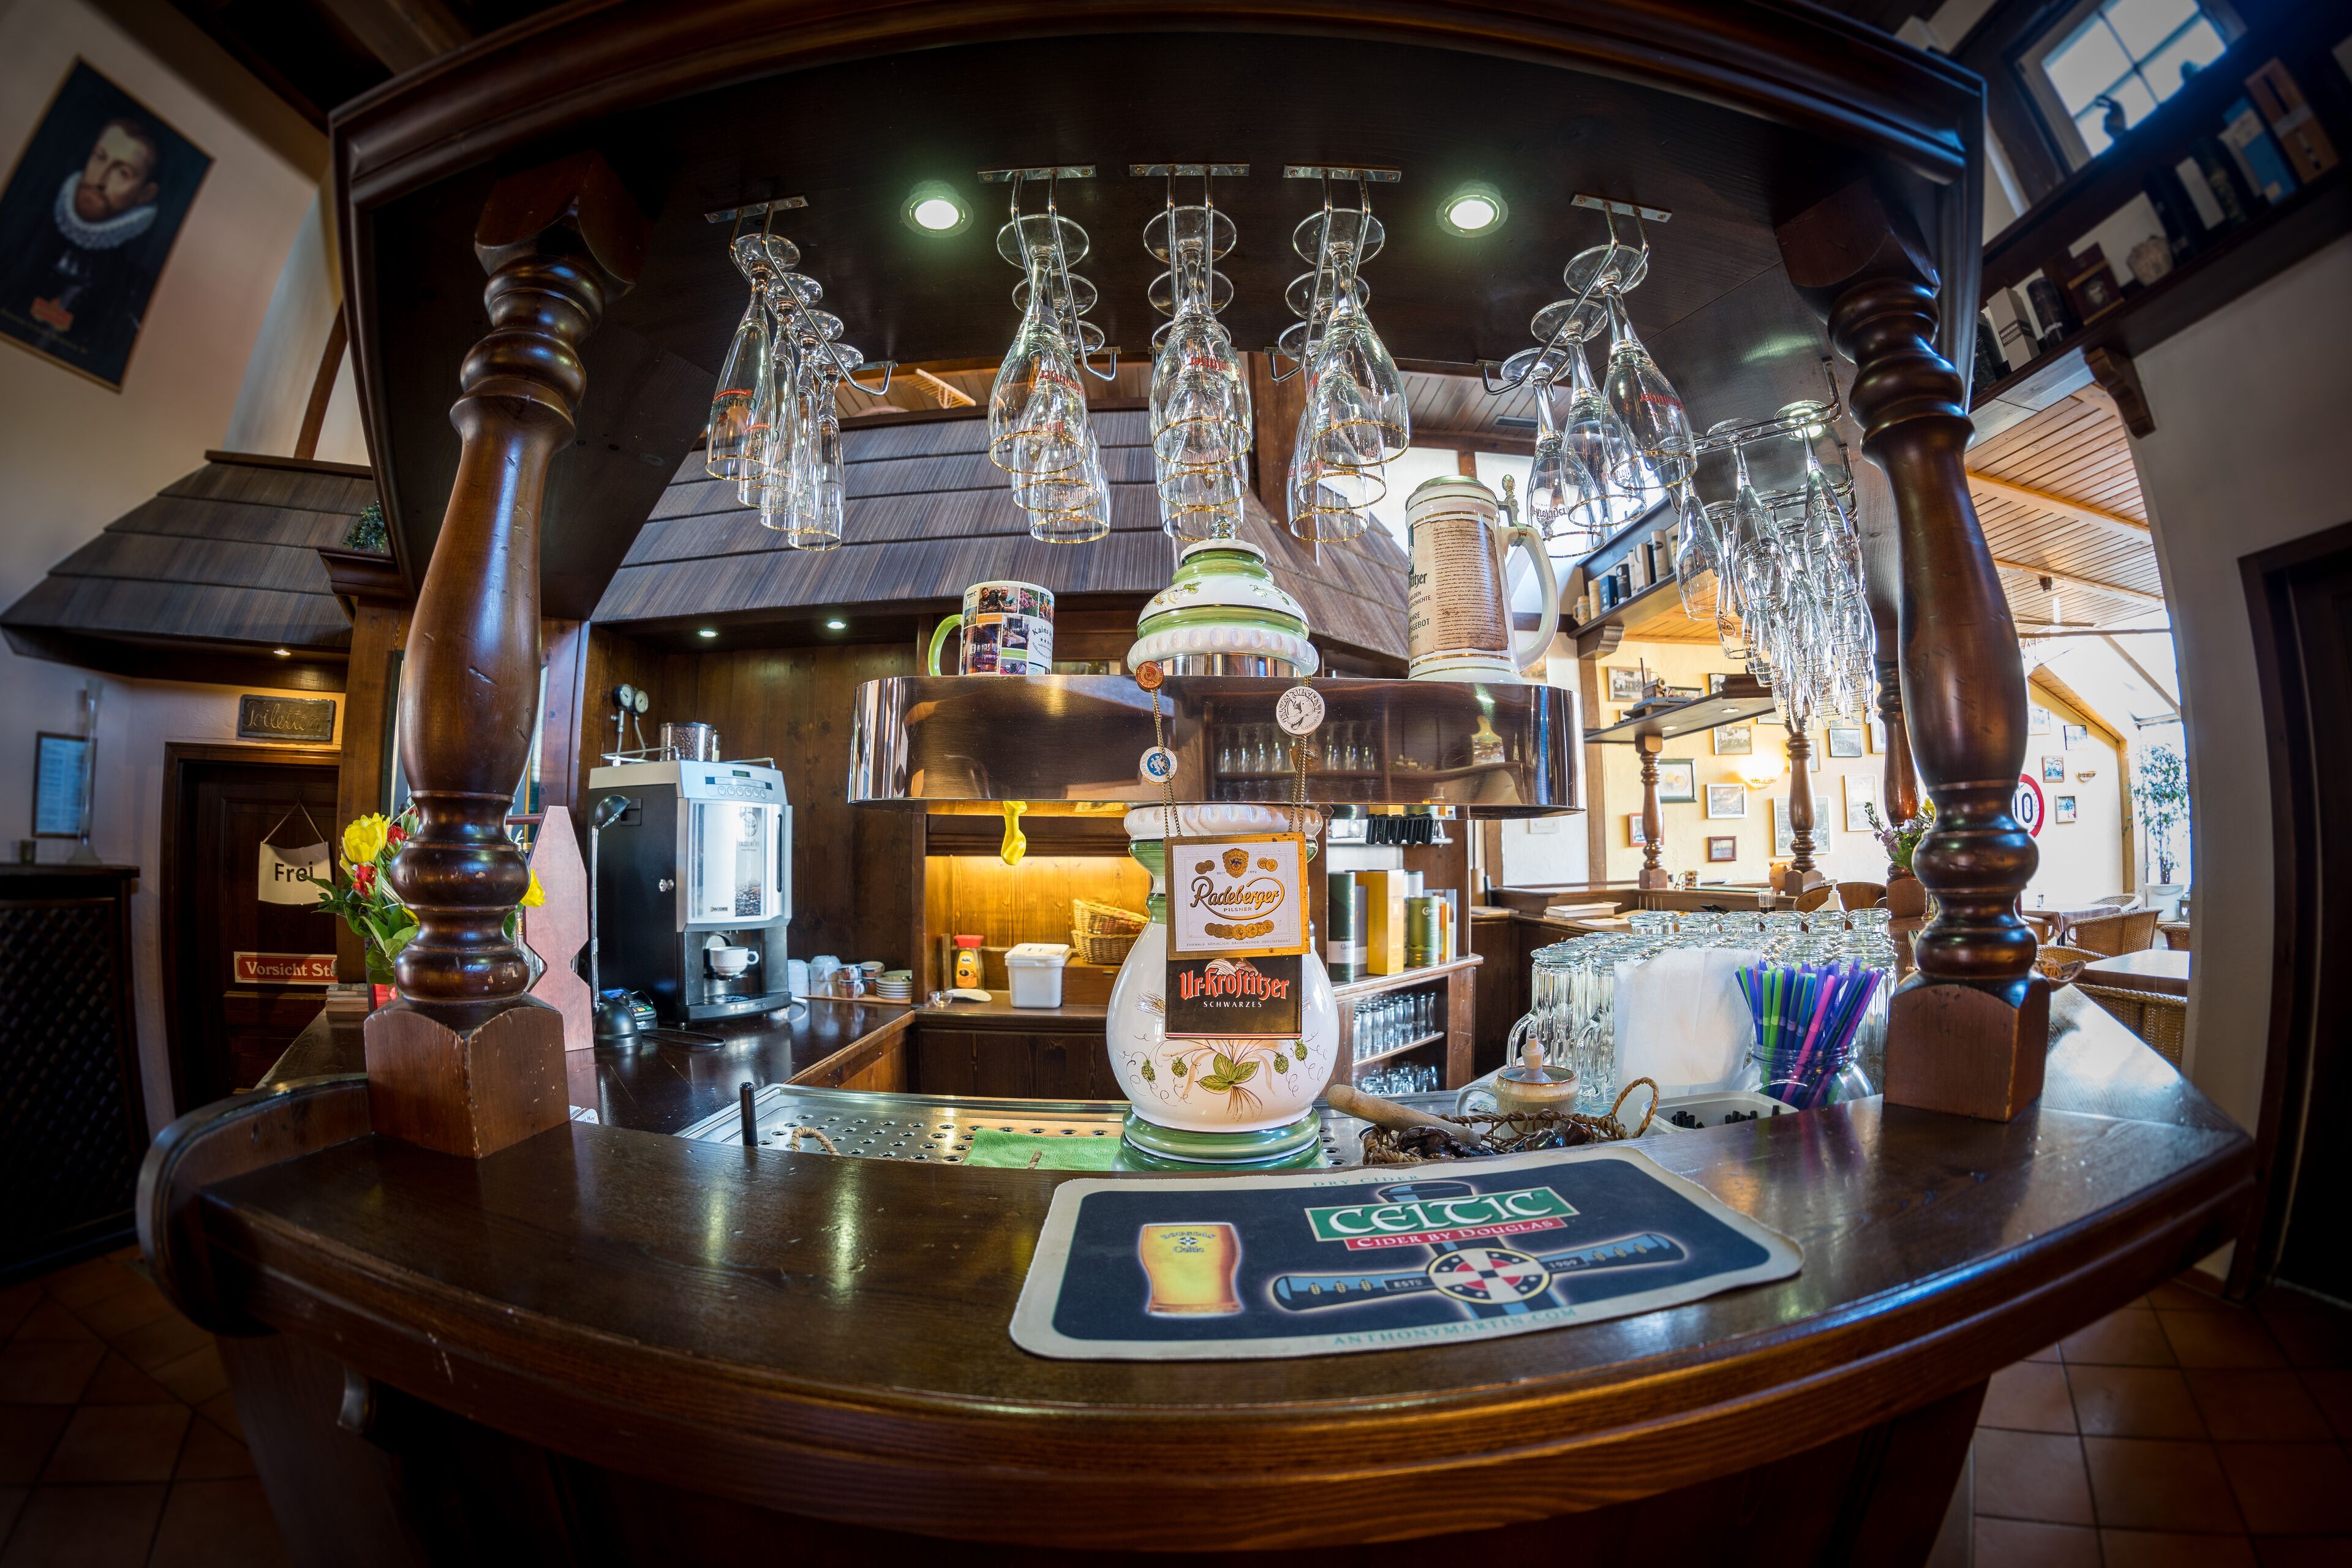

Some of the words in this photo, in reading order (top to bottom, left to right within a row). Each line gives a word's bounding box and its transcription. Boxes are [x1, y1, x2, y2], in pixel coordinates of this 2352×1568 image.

[244, 701, 322, 732] Toiletten
[274, 861, 314, 882] Frei
[1189, 876, 1280, 910] Radeberger
[245, 960, 307, 977] Vorsicht
[1359, 1175, 1420, 1183] CIDER
[1328, 1191, 1553, 1235] CELTIC
[1357, 1234, 1420, 1248] CIDER
[1428, 1231, 1451, 1242] BY
[1458, 1219, 1554, 1238] DOUGLAS
